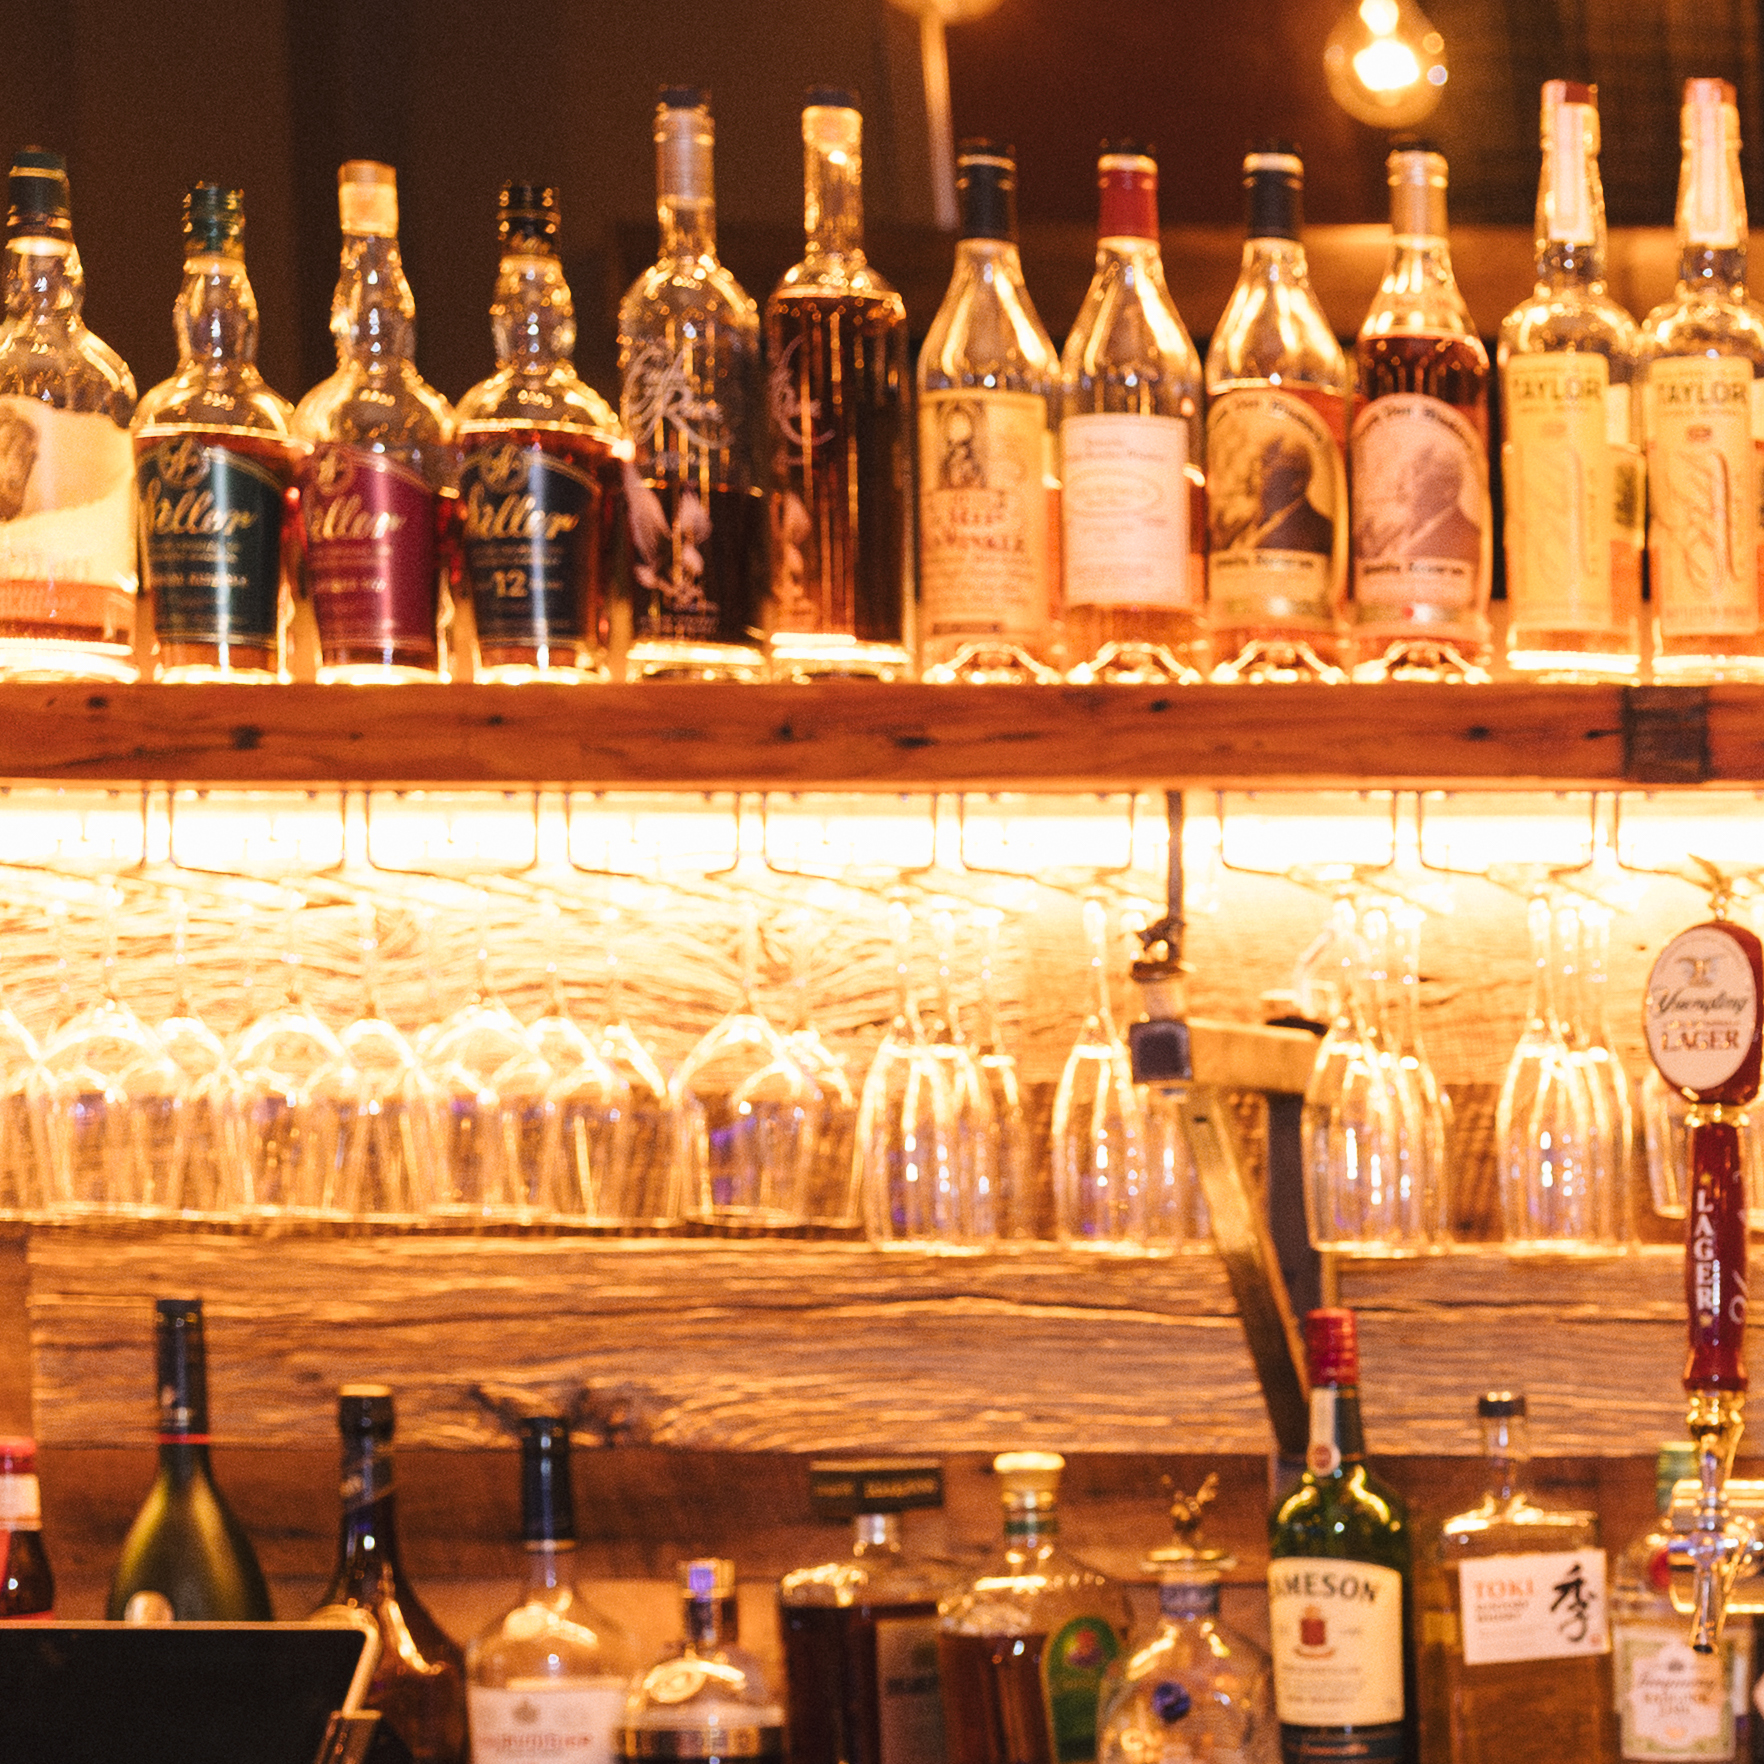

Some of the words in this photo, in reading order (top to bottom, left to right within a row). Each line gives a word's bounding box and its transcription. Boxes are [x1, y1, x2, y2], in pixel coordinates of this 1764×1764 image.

[494, 568, 528, 598] 12
[1661, 1029, 1740, 1052] LAGER
[1693, 1189, 1717, 1311] LAGER
[1475, 1577, 1535, 1599] TOKI
